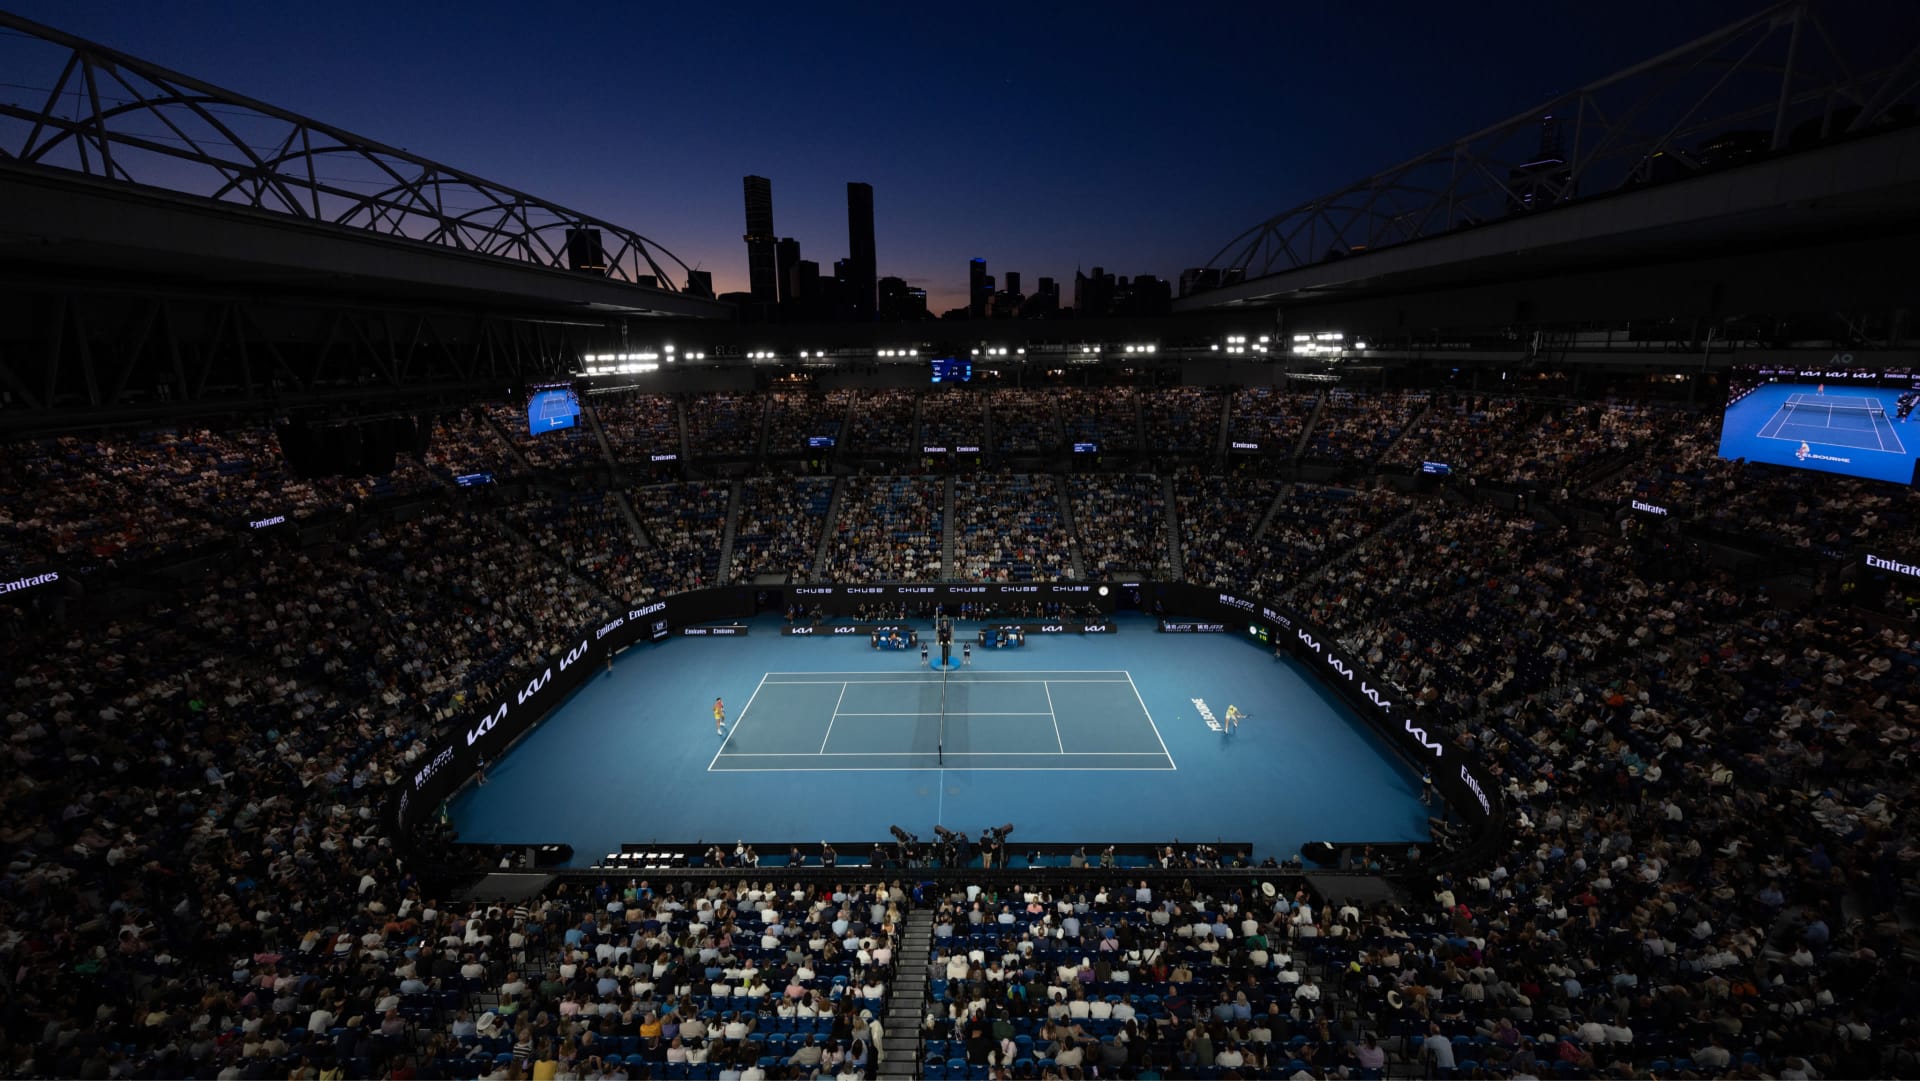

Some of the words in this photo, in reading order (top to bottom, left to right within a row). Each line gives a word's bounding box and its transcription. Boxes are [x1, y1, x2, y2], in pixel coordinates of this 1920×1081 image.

[596, 617, 624, 640] Emirates
[628, 601, 666, 621] Emirates
[467, 702, 508, 746] KIA
[518, 668, 551, 705] KIA
[560, 640, 588, 672] KIA
[1298, 629, 1320, 653] KIA
[1328, 653, 1353, 681] KIA
[1405, 719, 1443, 757] KIA
[1461, 764, 1490, 816] Emirates
